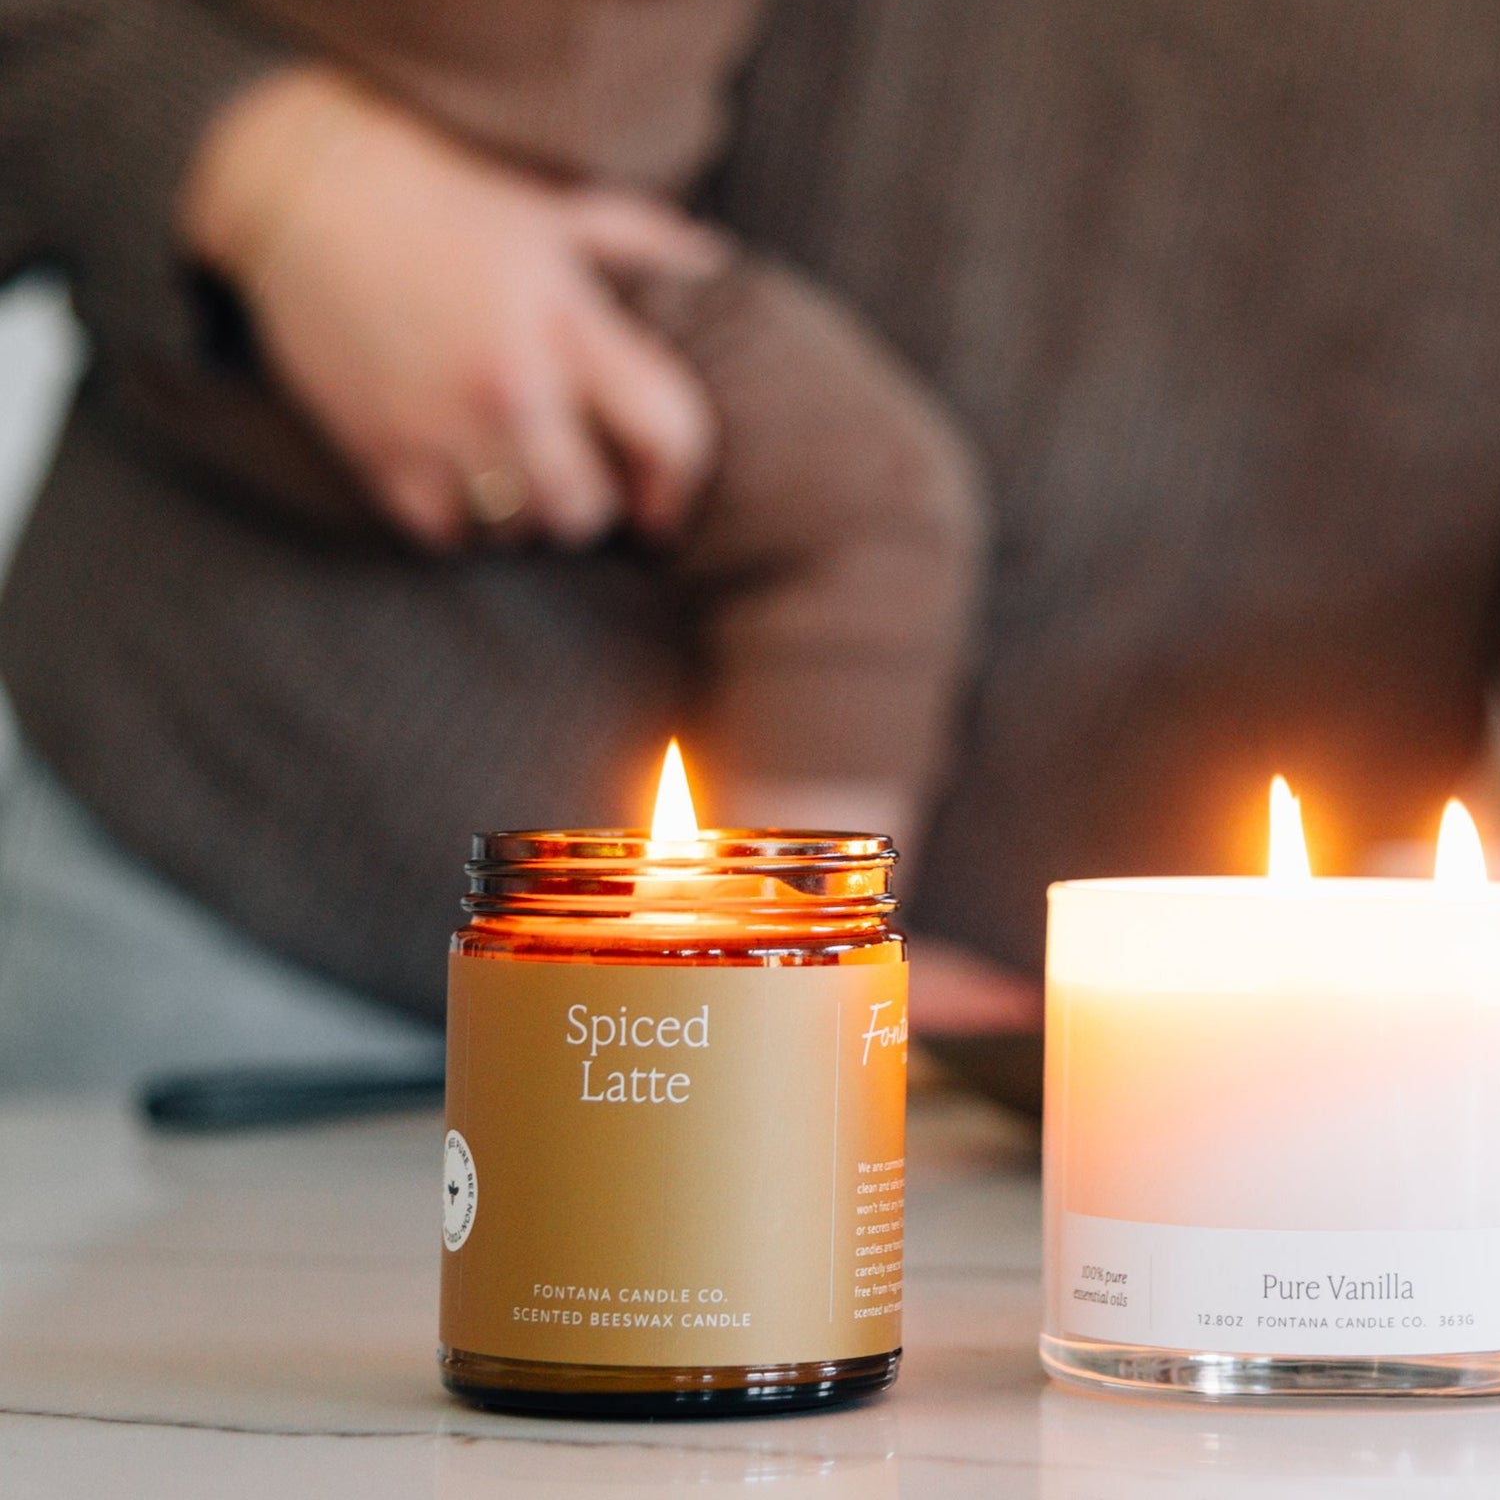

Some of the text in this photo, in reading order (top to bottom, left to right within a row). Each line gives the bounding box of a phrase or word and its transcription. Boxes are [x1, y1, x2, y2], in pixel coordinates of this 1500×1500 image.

[566, 1003, 710, 1056] Spiced
[580, 1060, 691, 1104] Latte
[858, 1162, 871, 1173] We
[467, 1173, 475, 1199] BEE
[857, 1182, 877, 1194] clean
[857, 1202, 878, 1215] won't
[856, 1226, 866, 1236] or
[855, 1262, 885, 1278] carefully
[1104, 1270, 1128, 1286] pure
[533, 1283, 728, 1303] FONTANA CANDLE CO.
[854, 1285, 871, 1298] free
[1262, 1272, 1415, 1301] Pure Vanilla
[1110, 1291, 1128, 1308] oils
[513, 1306, 752, 1328] SCENTED BEESWAX CANDLE
[853, 1304, 883, 1319] scented
[1257, 1316, 1329, 1329] FONTANA
[1335, 1316, 1396, 1329] CANDLE
[1401, 1316, 1428, 1328] CO.
[1439, 1314, 1475, 1327] 363G
